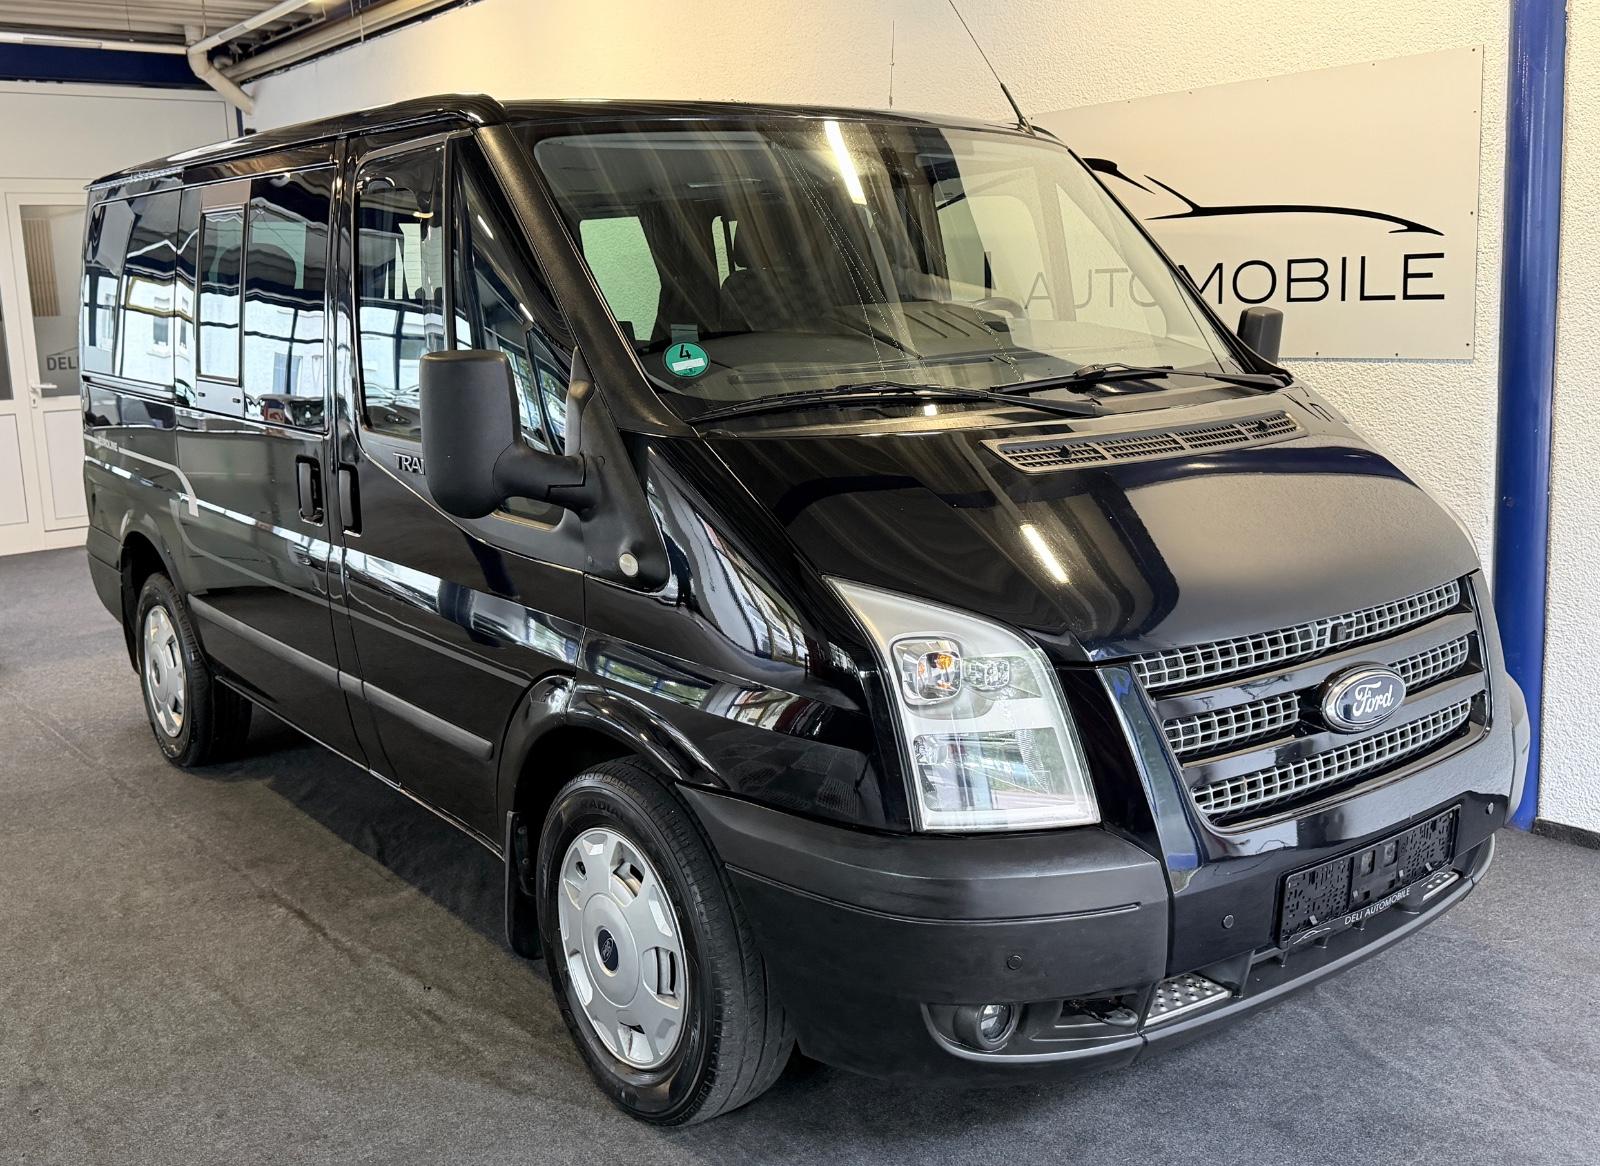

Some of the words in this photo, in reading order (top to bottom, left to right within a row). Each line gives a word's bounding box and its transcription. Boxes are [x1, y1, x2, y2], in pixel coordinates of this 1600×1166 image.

[679, 344, 691, 359] 4
[1352, 680, 1395, 717] Ford
[1344, 911, 1363, 925] DELI
[1364, 887, 1411, 918] AUTOMOBILE
